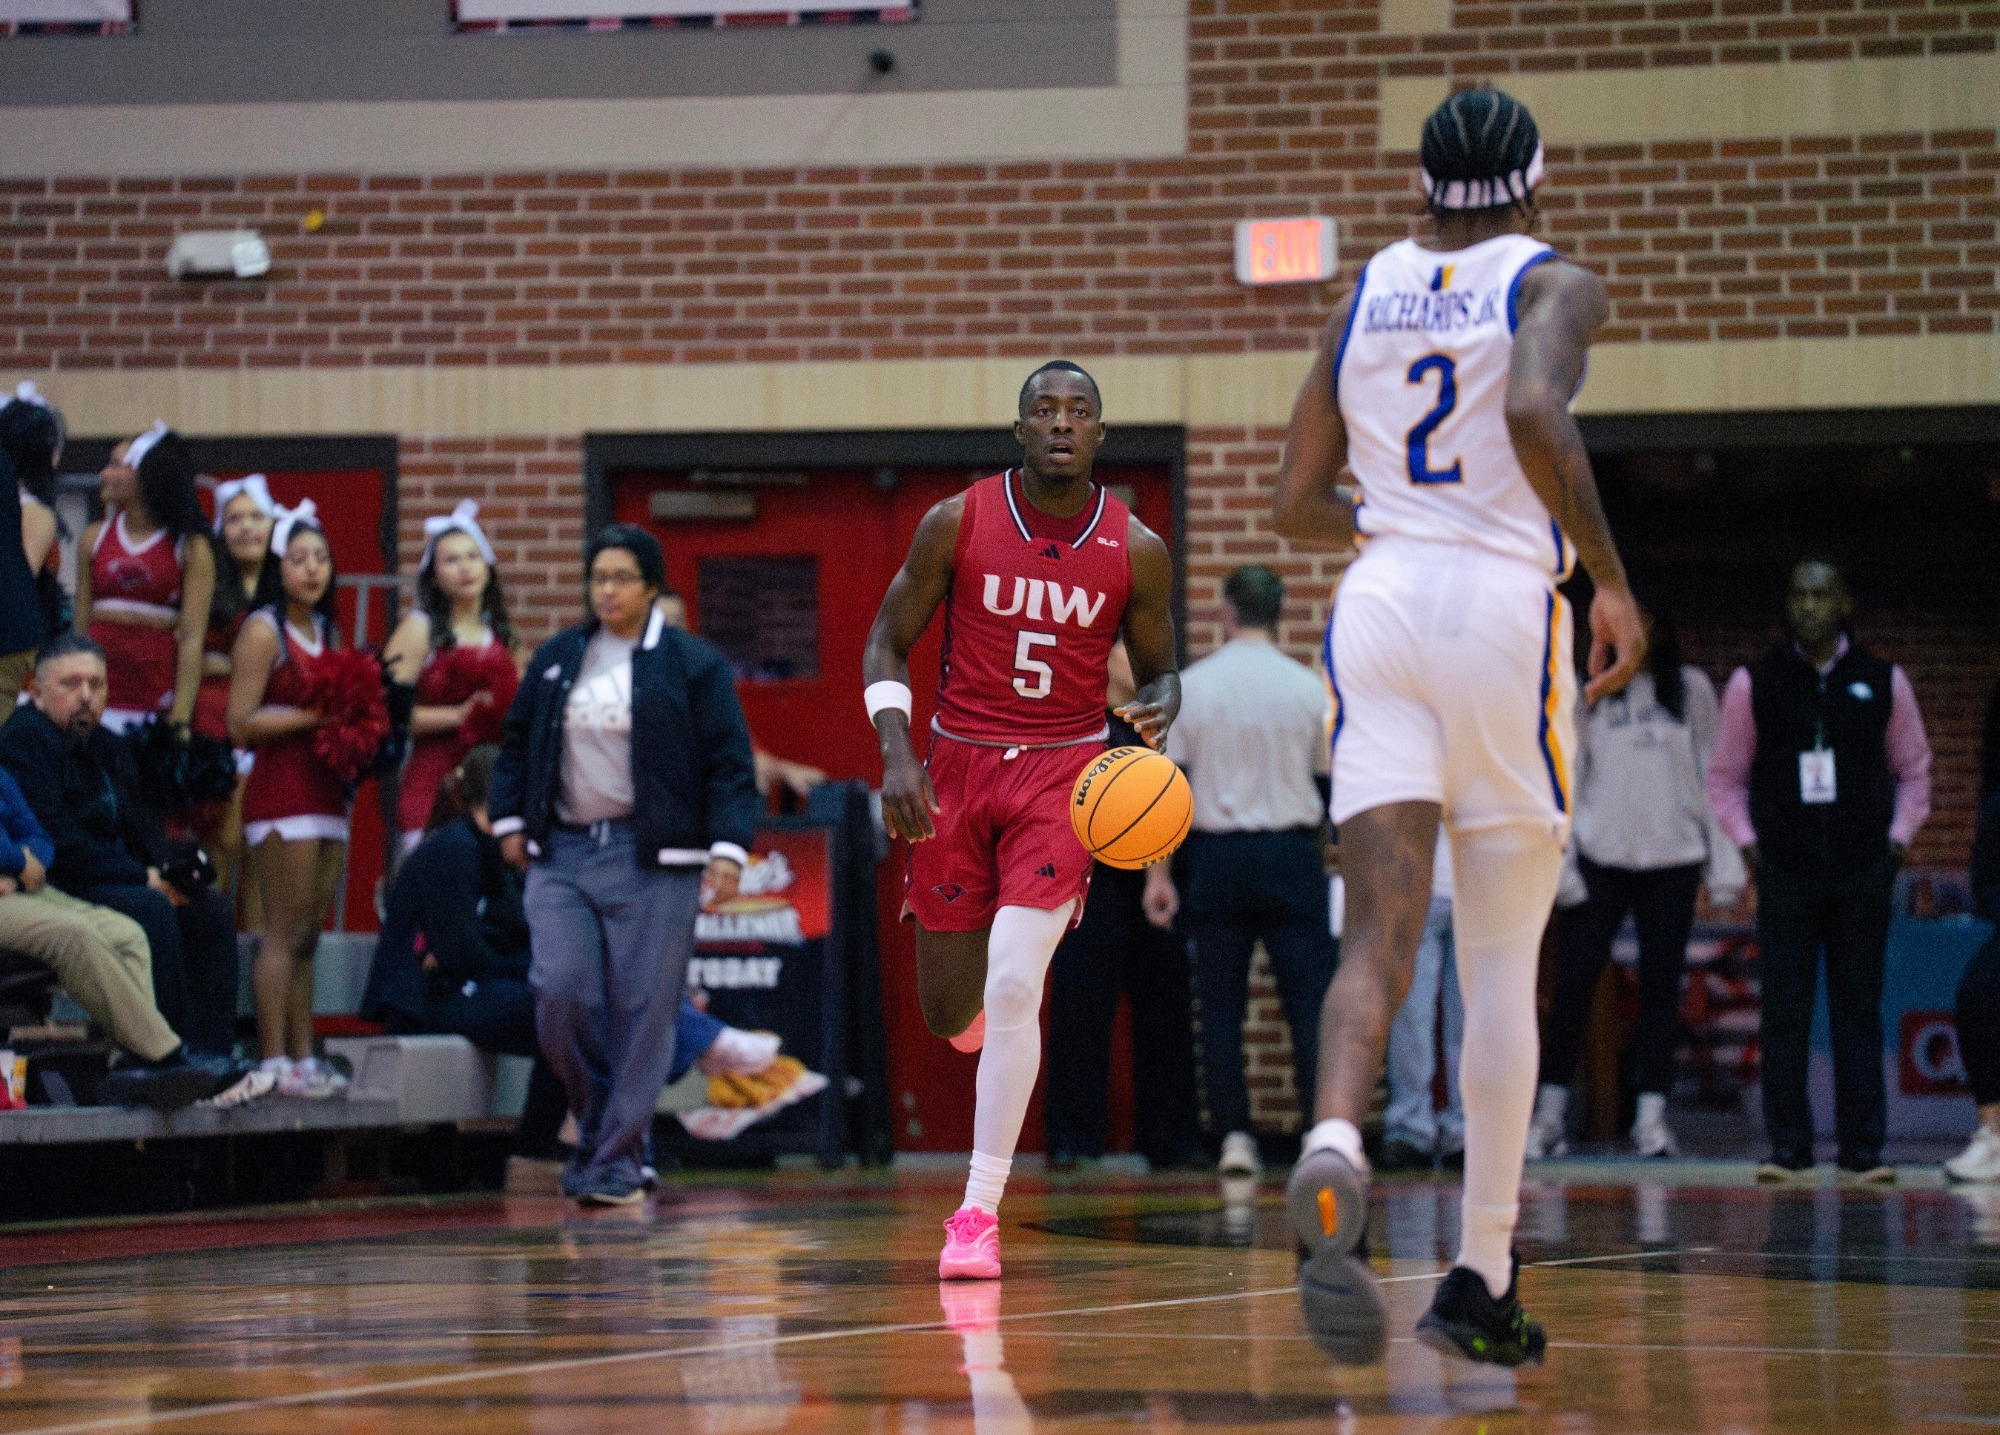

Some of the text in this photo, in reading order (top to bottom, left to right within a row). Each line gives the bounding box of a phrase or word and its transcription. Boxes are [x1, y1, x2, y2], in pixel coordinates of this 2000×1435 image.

[1407, 354, 1463, 484] 2
[983, 574, 1107, 628] UIW
[1012, 630, 1057, 699] 5
[1076, 747, 1138, 806] Wilson
